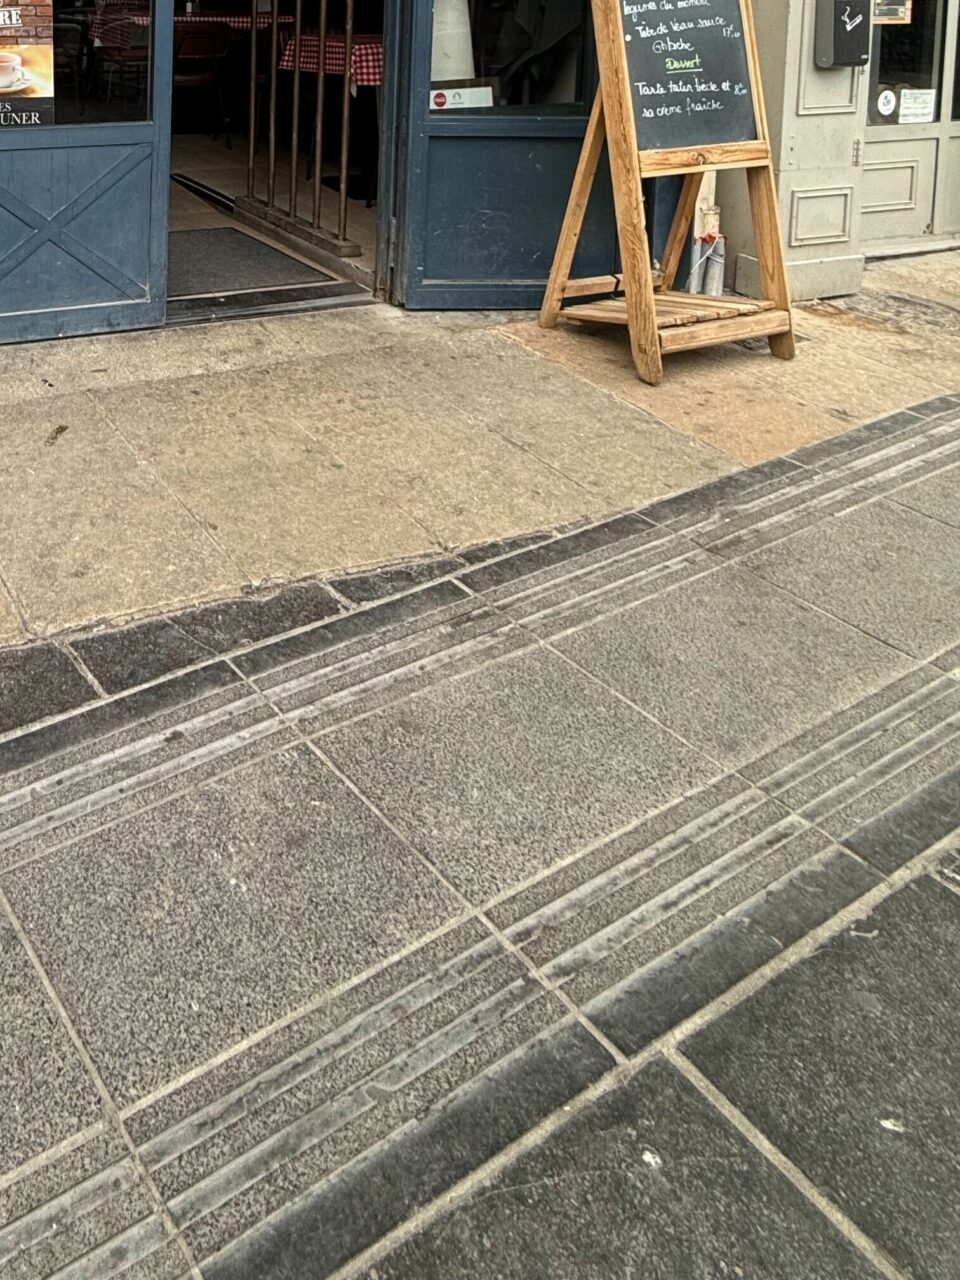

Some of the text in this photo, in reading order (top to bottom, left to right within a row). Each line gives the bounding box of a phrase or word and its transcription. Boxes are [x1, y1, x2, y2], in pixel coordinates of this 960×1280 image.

[660, 0, 675, 10] du
[657, 23, 669, 35] de
[697, 16, 726, 28] sauce
[665, 53, 702, 70] Dessert
[634, 82, 667, 96] Tarte
[668, 80, 694, 93] tatin
[722, 80, 732, 92] et
[642, 109, 654, 118] sa
